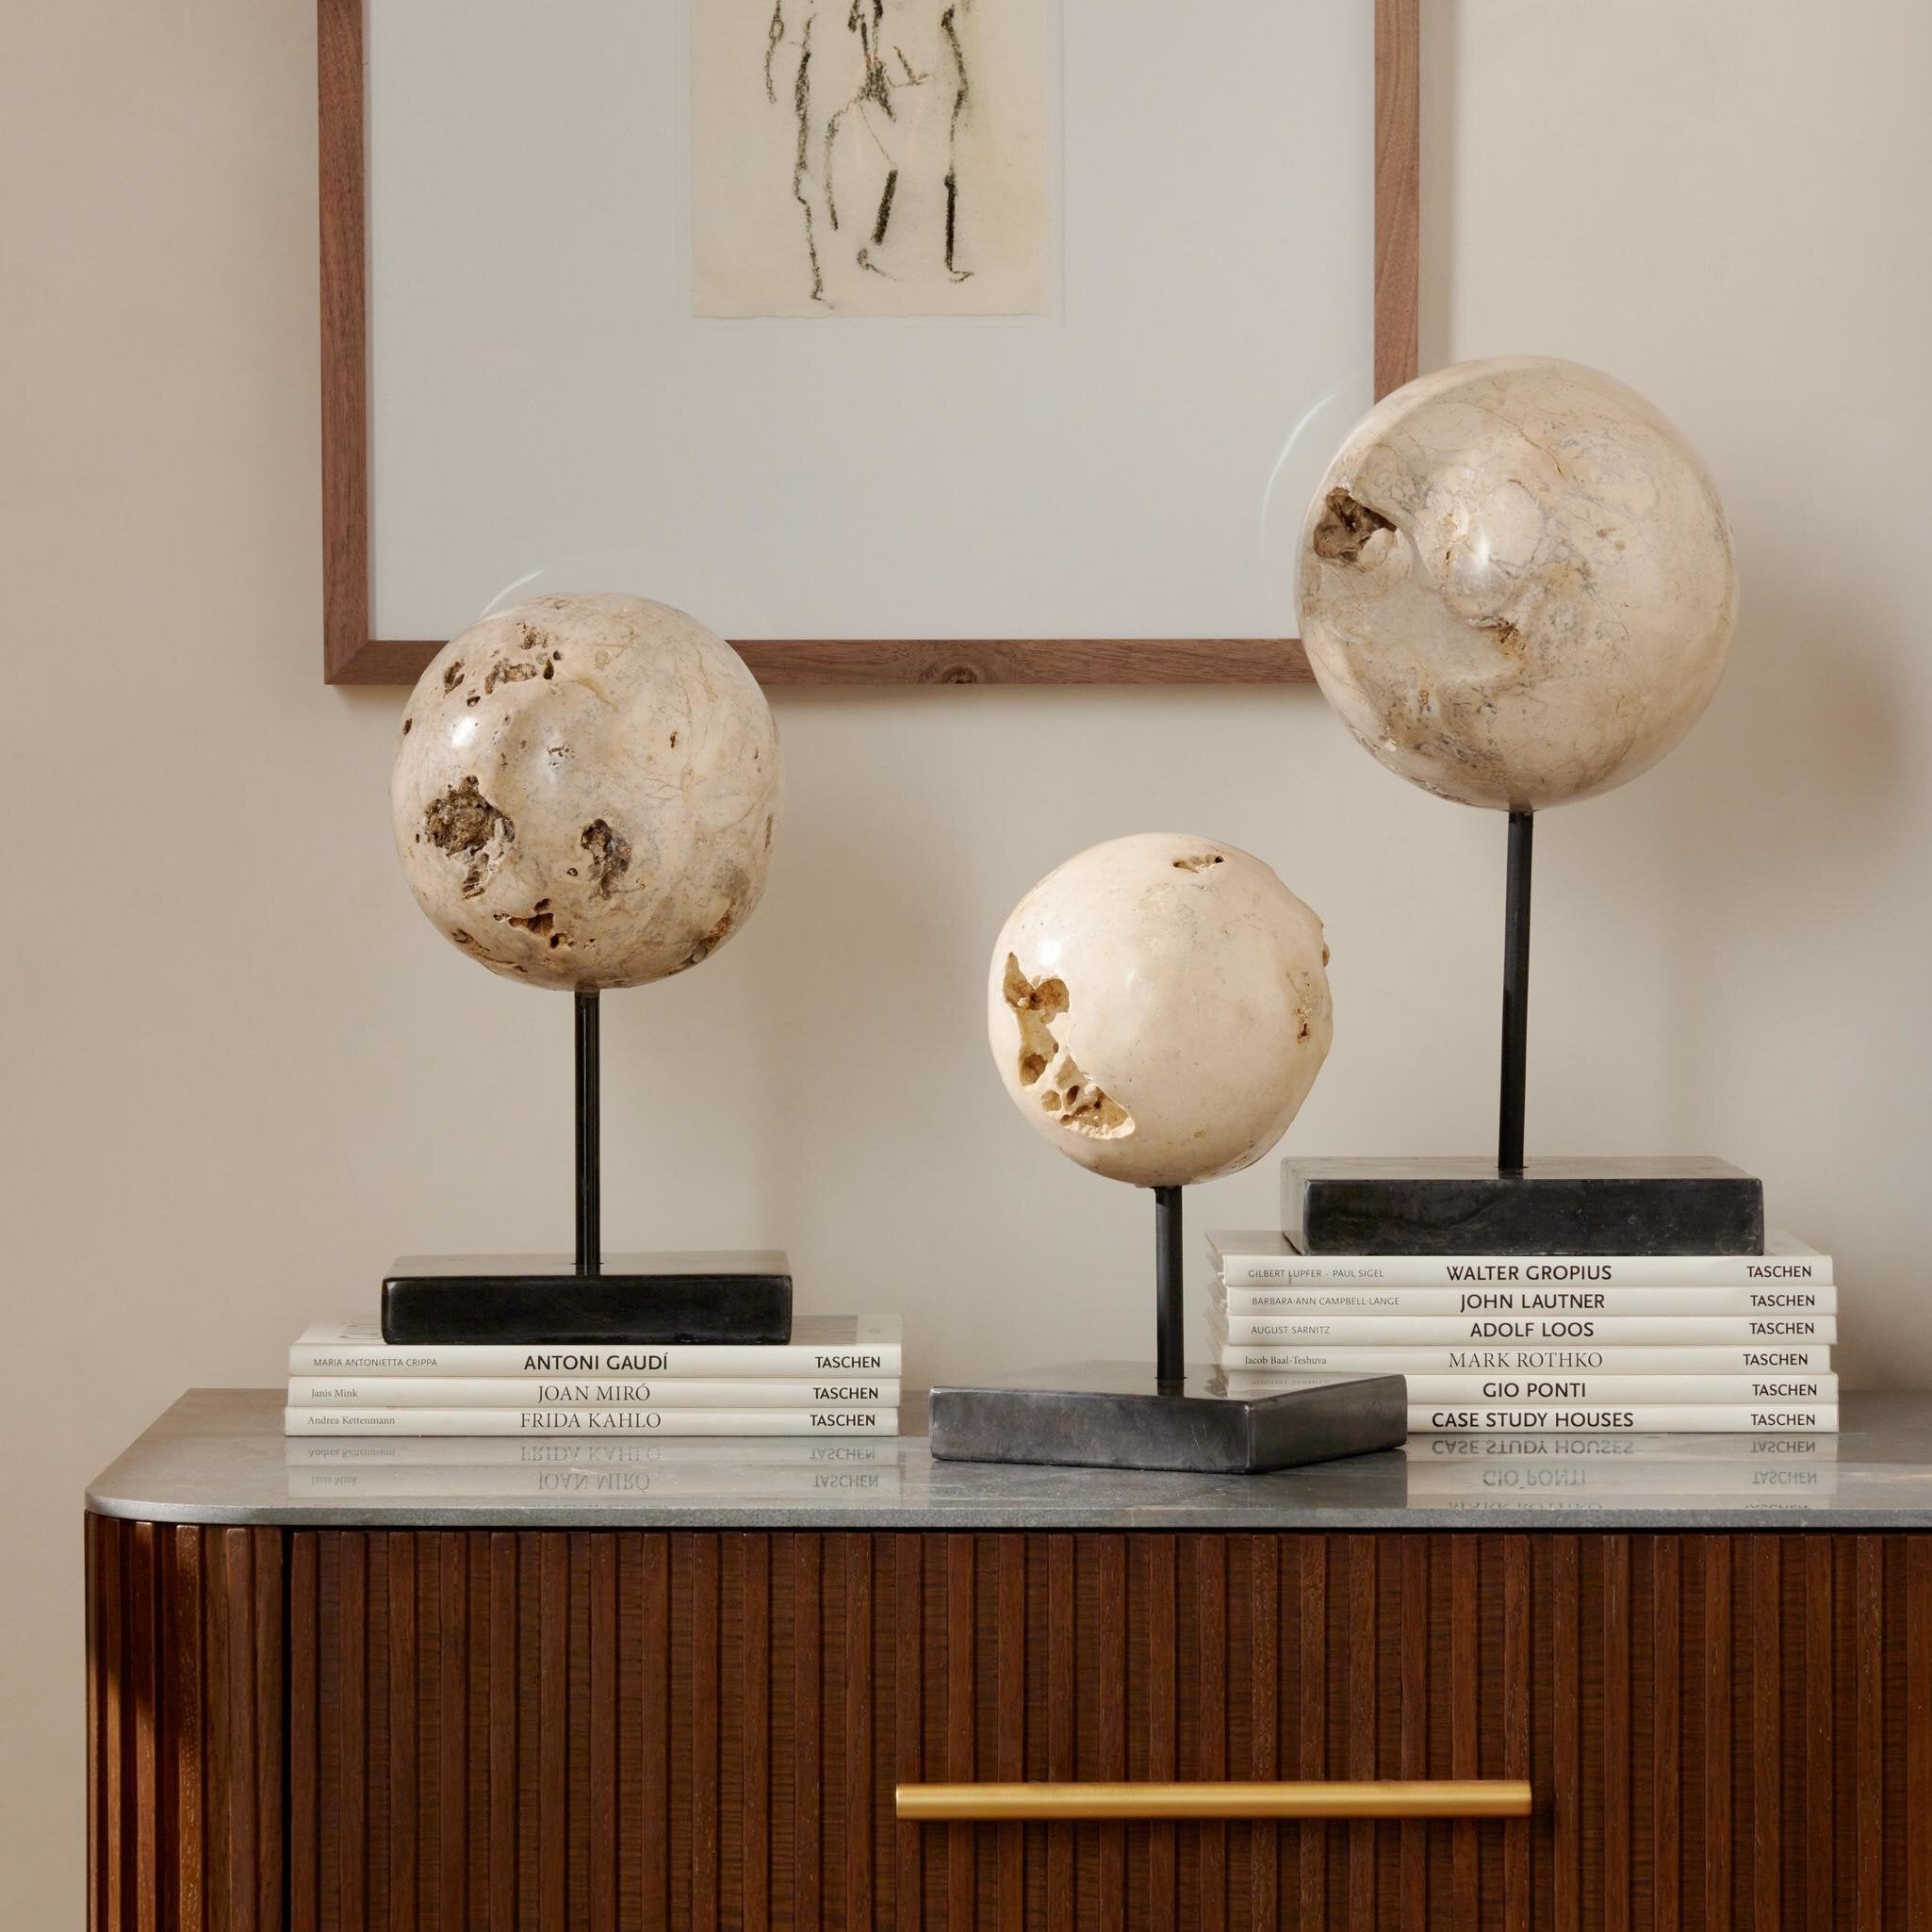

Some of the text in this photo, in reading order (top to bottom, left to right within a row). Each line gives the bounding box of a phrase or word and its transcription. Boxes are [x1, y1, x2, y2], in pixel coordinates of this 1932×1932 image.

[1248, 1269, 1285, 1278] GILBERT
[1288, 1269, 1322, 1278] LUPFER
[1332, 1269, 1356, 1278] PAUL
[1358, 1269, 1384, 1278] SIGEL
[1446, 1265, 1613, 1282] WALTER GROPIUS
[1746, 1266, 1812, 1279] TASCHEN
[1460, 1293, 1606, 1312] JOHN LAUTNER
[1749, 1294, 1815, 1307] TASCHEN
[1251, 1325, 1331, 1334] AUGUST SARNITZ
[1469, 1321, 1595, 1338] ADOLF LOOS
[1749, 1322, 1815, 1335] TASCHEN
[313, 1358, 438, 1367] MARIA ANTONIETTA CRIPPA
[523, 1351, 668, 1371] ANTONI GAUDÍ
[815, 1356, 881, 1368] TASCHEN
[1244, 1355, 1269, 1367] Jacob
[1448, 1352, 1603, 1369] MARK ROTHKO
[1743, 1353, 1809, 1367] TASCHEN
[310, 1388, 358, 1398] Janis Mink
[537, 1383, 650, 1403] JOAN MIRÓ
[812, 1387, 879, 1400] TASCHEN
[1482, 1382, 1586, 1399] GIO PONTI
[1752, 1384, 1817, 1397] TASCHEN
[307, 1416, 396, 1425] Andrea Kettenmann
[519, 1413, 663, 1429] FRIDA KAHLO
[810, 1415, 876, 1427] TASCHEN
[1432, 1411, 1634, 1428] CASE STUDY HOUSES
[1750, 1413, 1816, 1426] TASCHEN
